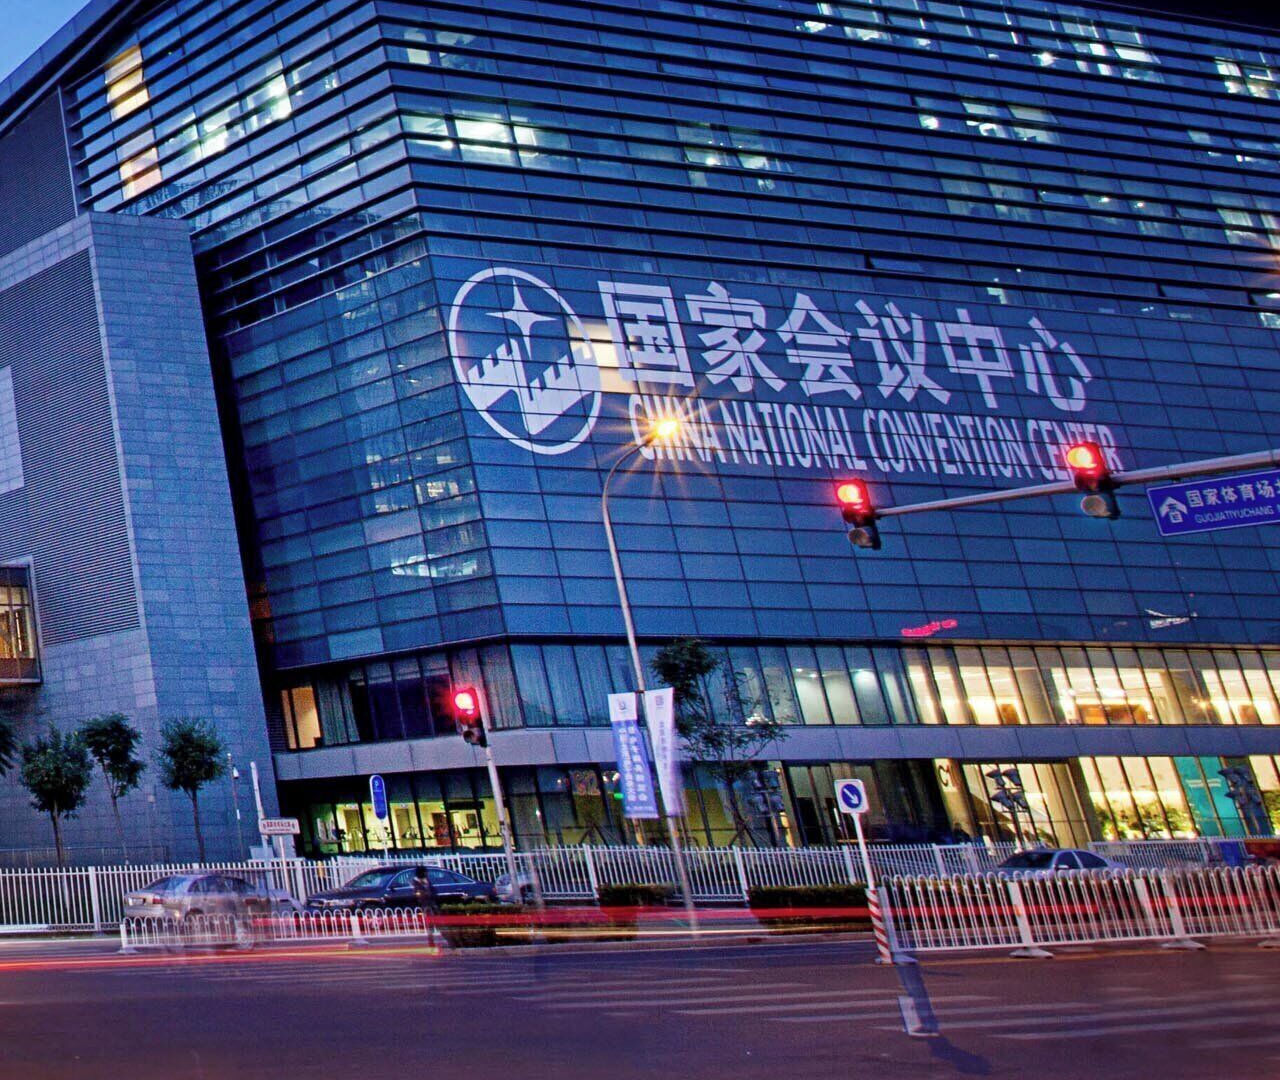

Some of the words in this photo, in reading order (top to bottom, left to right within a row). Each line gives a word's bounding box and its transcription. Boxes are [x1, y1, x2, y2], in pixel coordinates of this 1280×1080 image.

[597, 280, 1095, 412] 国家会议中心
[628, 394, 727, 464] CHINA
[718, 400, 868, 471] NATIONAL
[862, 409, 1033, 480] CONVENTION
[1194, 505, 1275, 524] GUOJIATIYUCHANG
